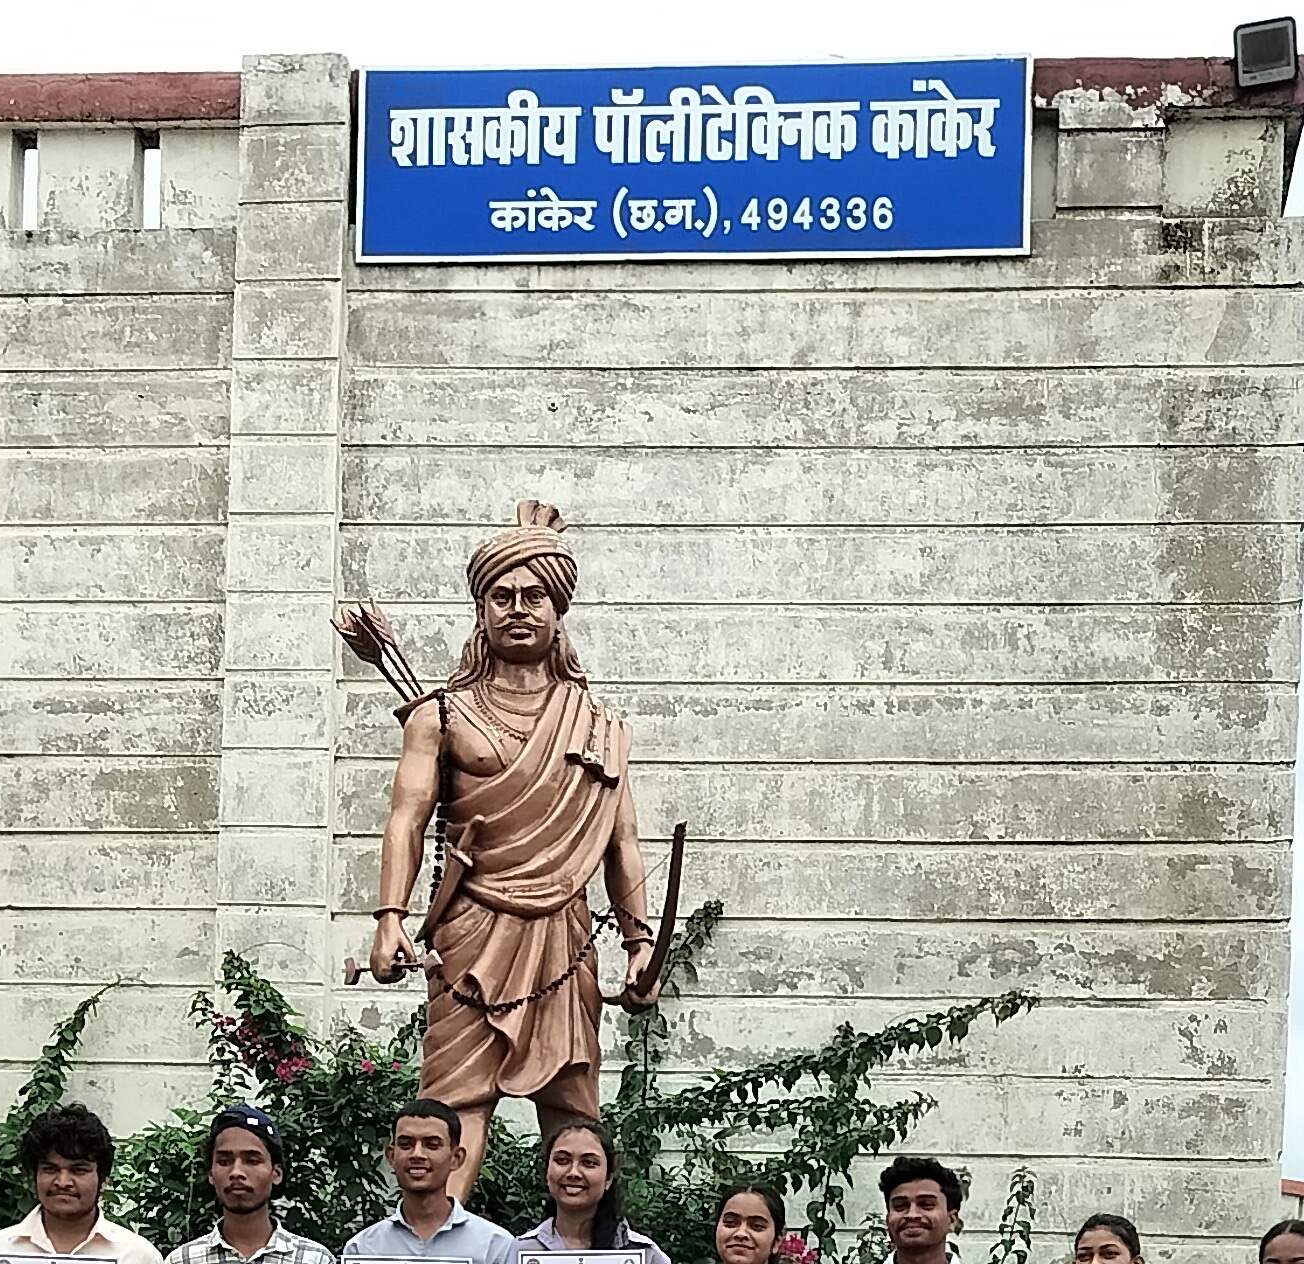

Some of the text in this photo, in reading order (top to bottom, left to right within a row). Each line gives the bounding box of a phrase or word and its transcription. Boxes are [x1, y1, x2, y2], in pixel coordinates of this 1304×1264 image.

[390, 79, 1001, 167] शासकीय पॉलीटेक्निक कांकेर
[489, 186, 598, 232] कांकेर
[740, 197, 893, 231] 494336
